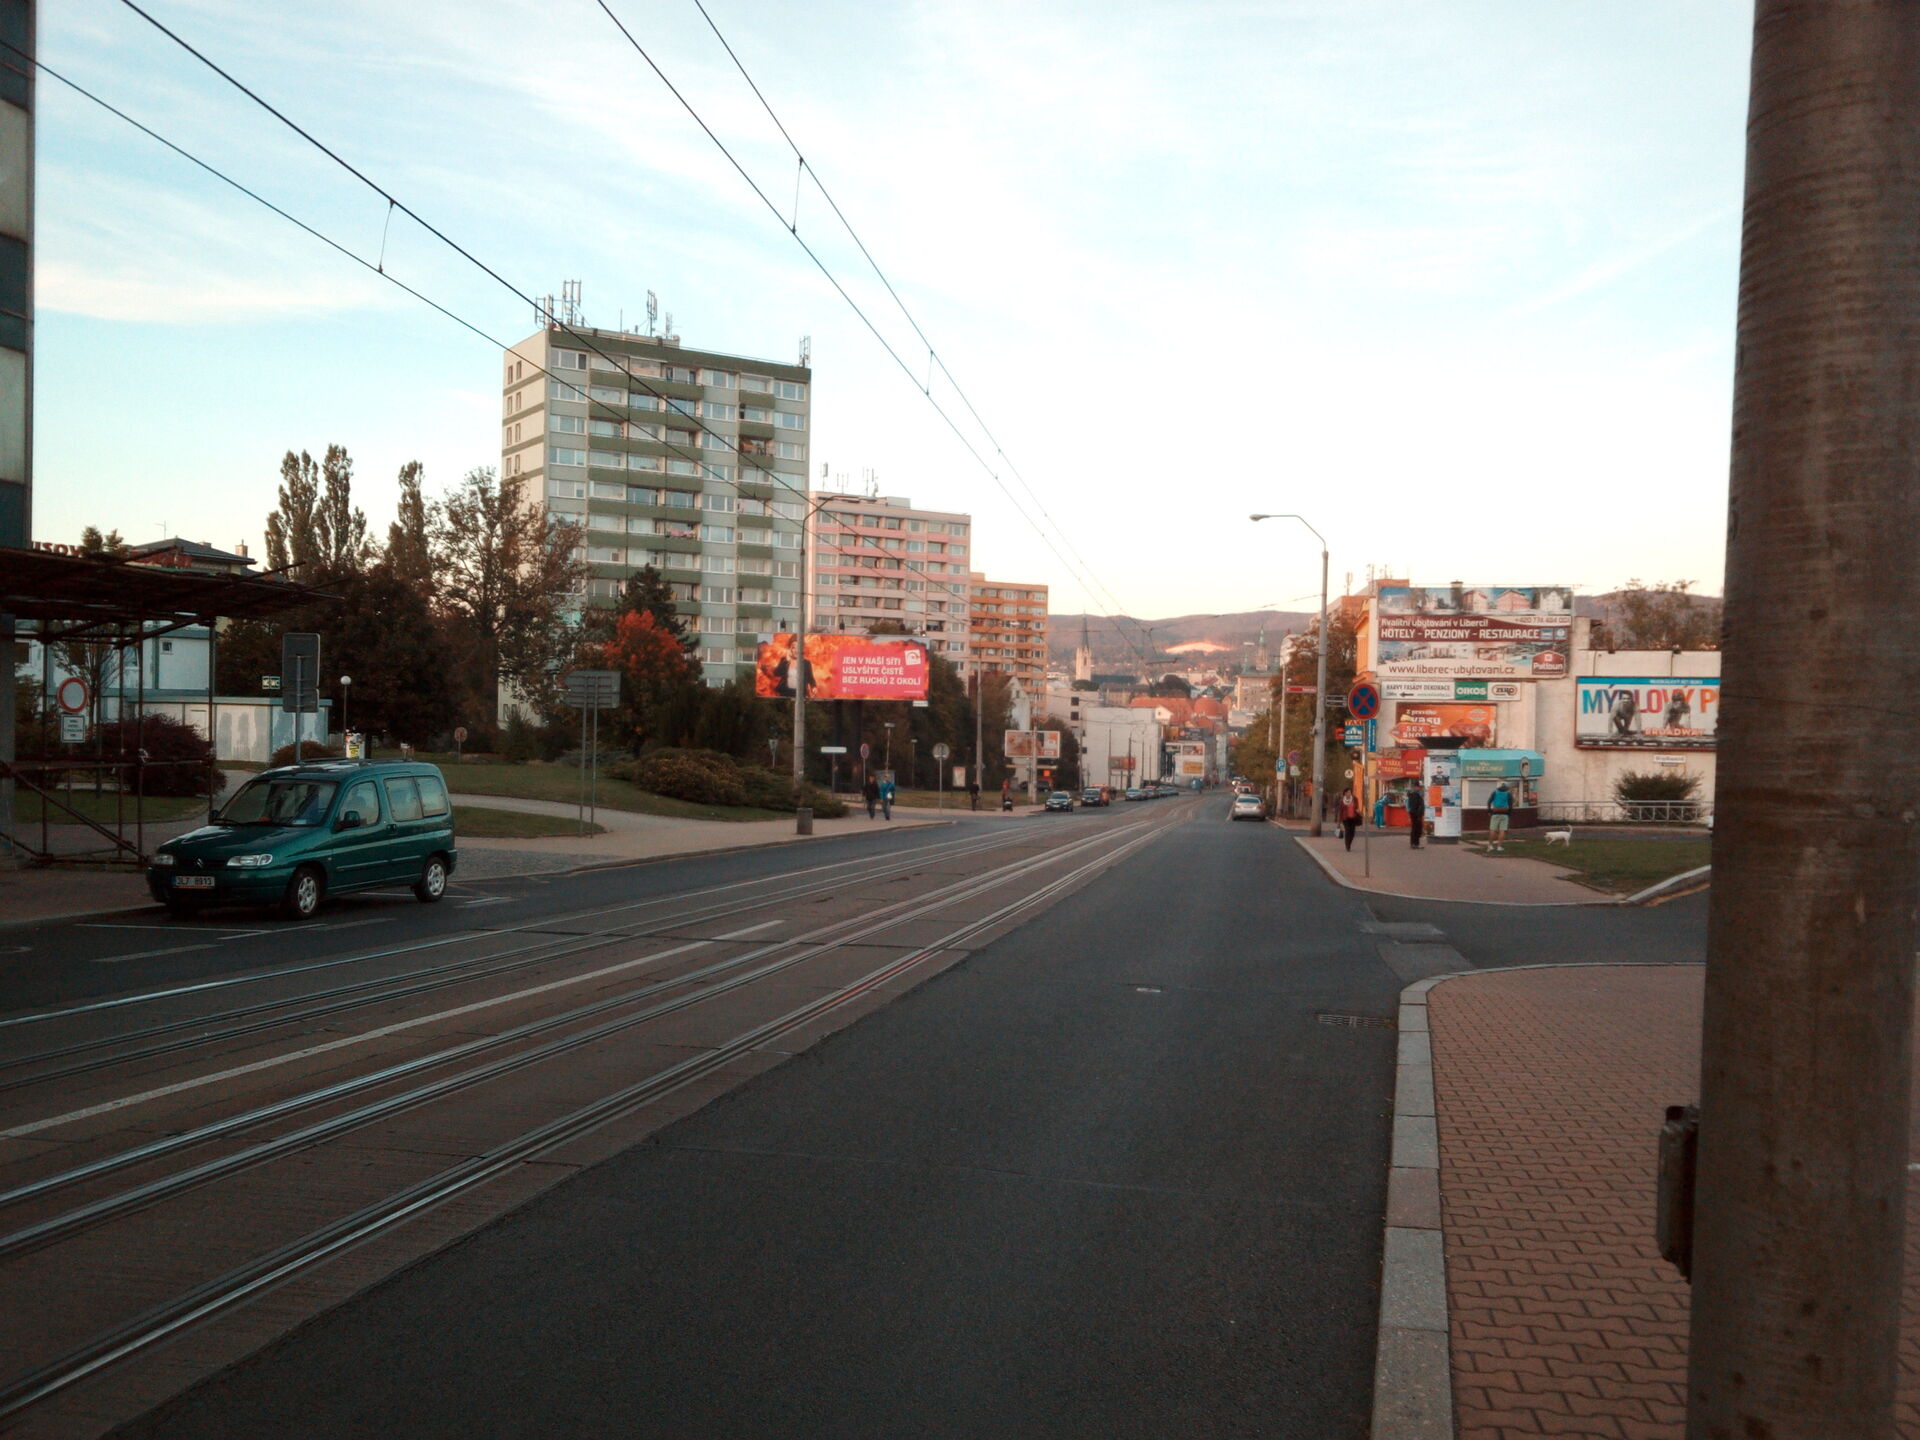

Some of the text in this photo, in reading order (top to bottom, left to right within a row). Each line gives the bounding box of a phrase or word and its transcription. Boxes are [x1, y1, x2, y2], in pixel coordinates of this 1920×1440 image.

[1381, 618, 1411, 627] Kvalitní
[1412, 618, 1452, 629] ubytování
[1459, 618, 1489, 627] Liberci!
[1381, 628, 1416, 638] HOTELY
[1424, 629, 1471, 639] PENZIONY
[1479, 629, 1540, 639] RESTAURACE
[842, 656, 857, 664] JEN
[858, 657, 864, 665] V
[865, 656, 884, 665] NAŠÍ
[842, 665, 880, 674] USLYŠÍTE
[842, 676, 858, 684] BEZ
[1456, 687, 1487, 695] OIKOS
[1644, 728, 1706, 736] BROADWAY
